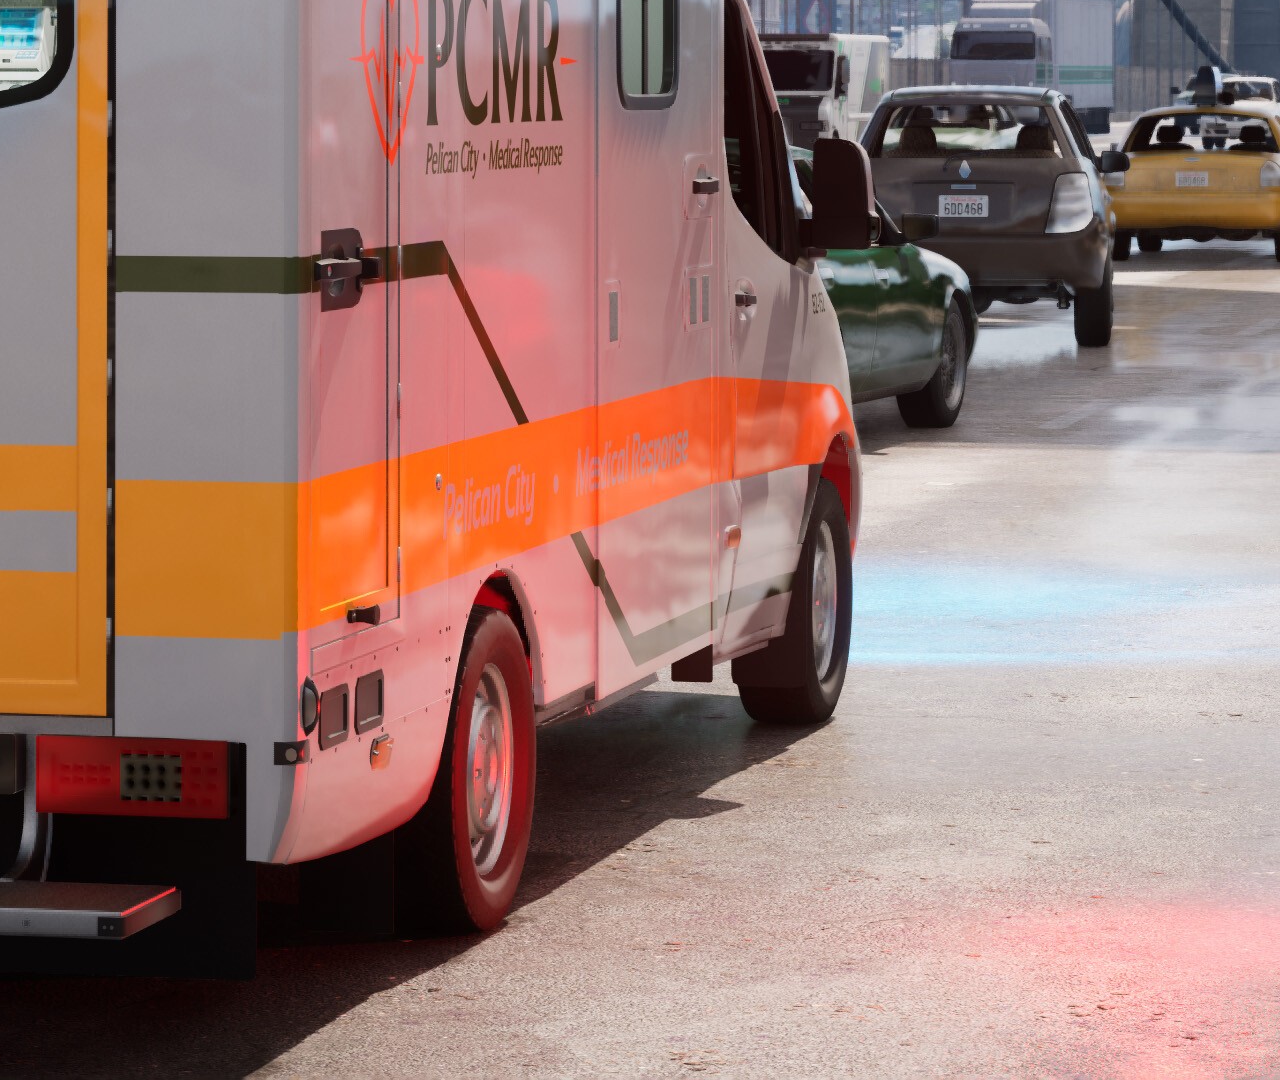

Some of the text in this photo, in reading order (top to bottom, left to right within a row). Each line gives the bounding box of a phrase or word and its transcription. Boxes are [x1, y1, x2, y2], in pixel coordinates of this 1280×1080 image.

[426, 138, 563, 179] Pelican City Medical Response
[944, 202, 983, 215] 6DD468
[443, 429, 689, 540] Pelican City Medical Response
